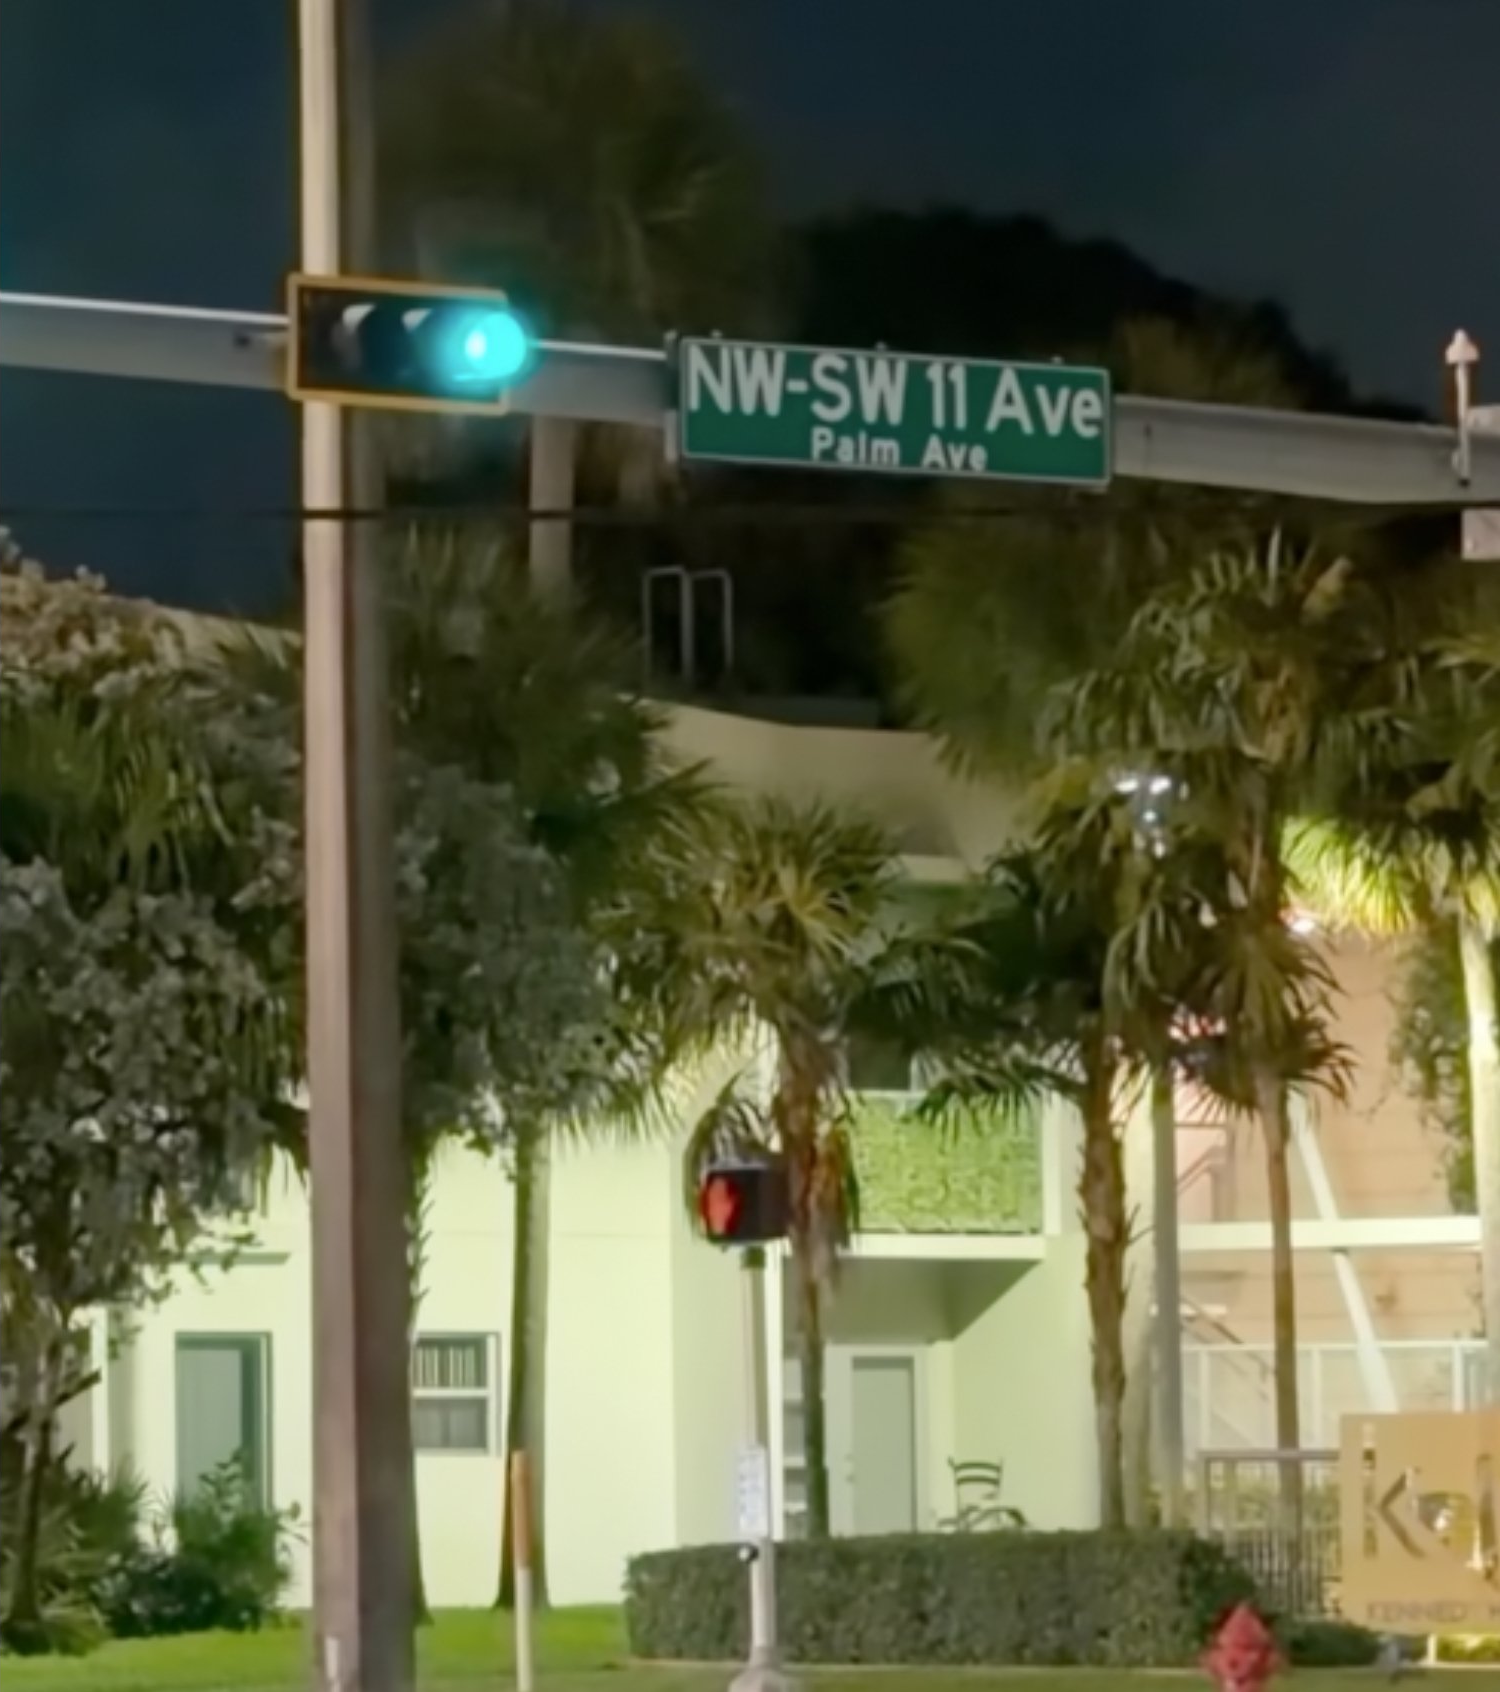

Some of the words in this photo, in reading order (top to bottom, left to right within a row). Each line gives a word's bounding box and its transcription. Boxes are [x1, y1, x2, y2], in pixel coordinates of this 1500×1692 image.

[687, 345, 907, 426] NW-SW
[926, 363, 967, 430] 11
[986, 367, 1105, 438] Ave
[811, 427, 900, 466] Palm
[922, 435, 988, 472] Ave
